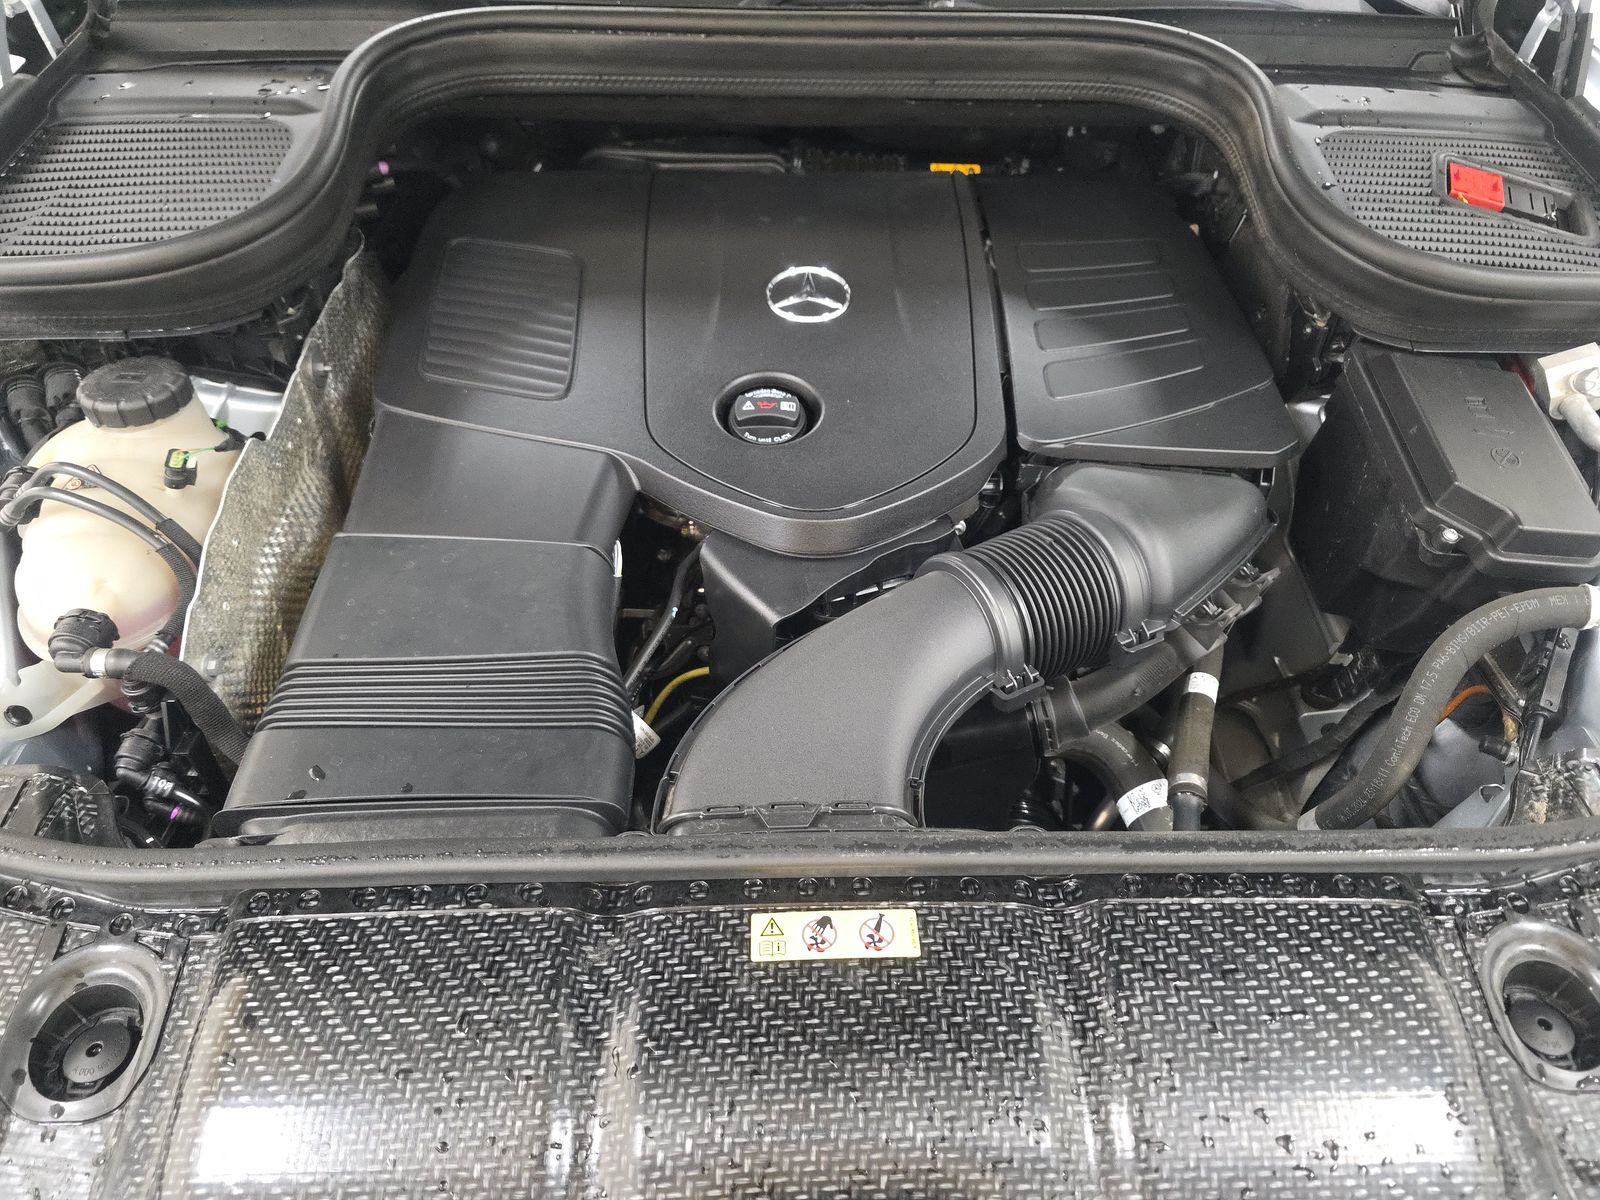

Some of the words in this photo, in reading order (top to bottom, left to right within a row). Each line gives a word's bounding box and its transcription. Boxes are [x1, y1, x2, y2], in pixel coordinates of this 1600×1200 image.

[744, 431, 757, 441] Turn
[773, 432, 792, 442] CLICK
[152, 776, 174, 791] TOP
